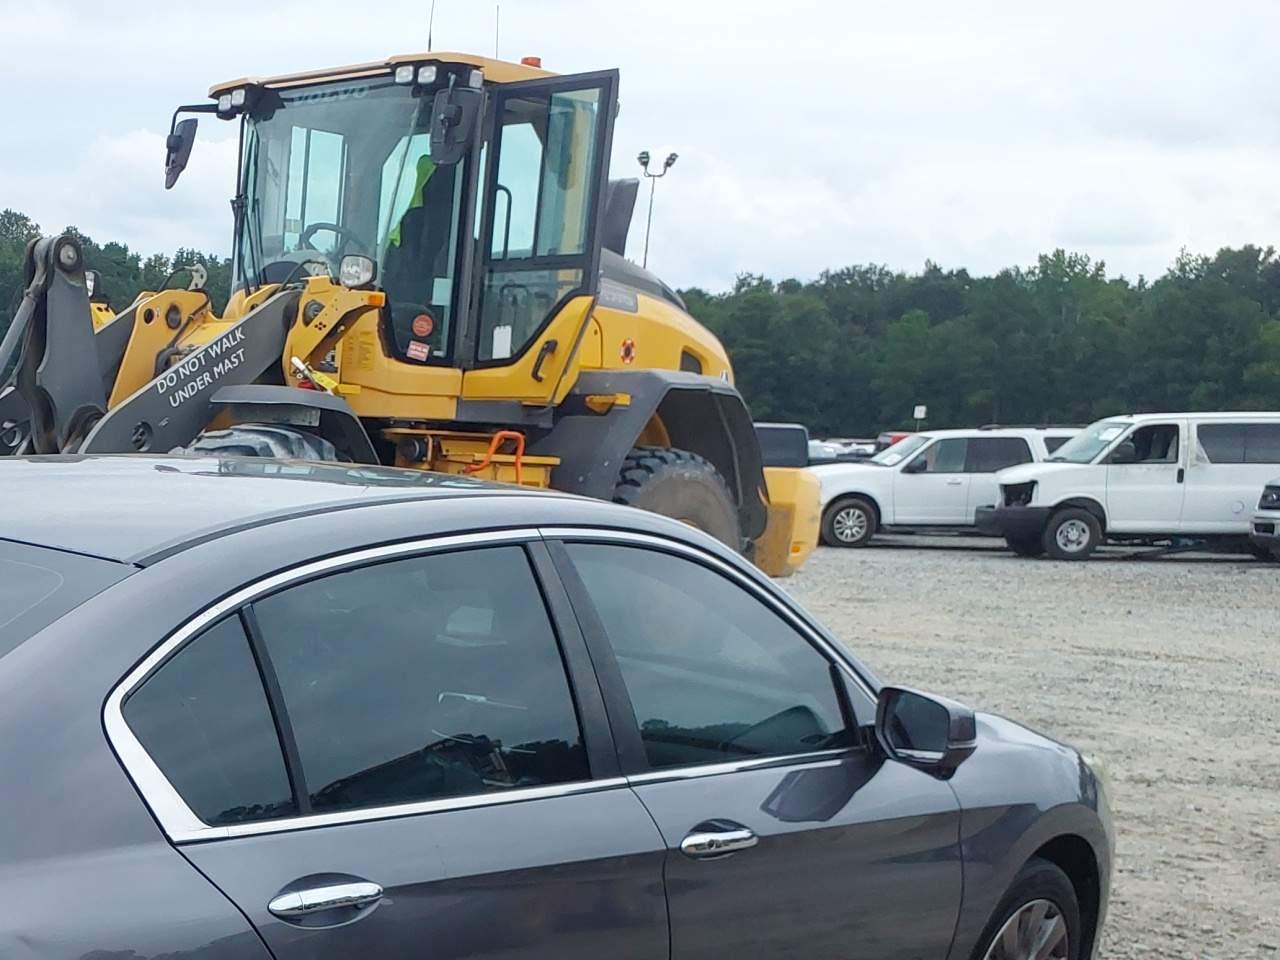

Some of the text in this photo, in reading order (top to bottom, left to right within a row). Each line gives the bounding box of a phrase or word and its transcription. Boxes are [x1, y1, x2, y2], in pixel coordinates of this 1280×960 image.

[156, 327, 246, 394] DO NOT WALK
[169, 348, 245, 408] UNDER MAST
